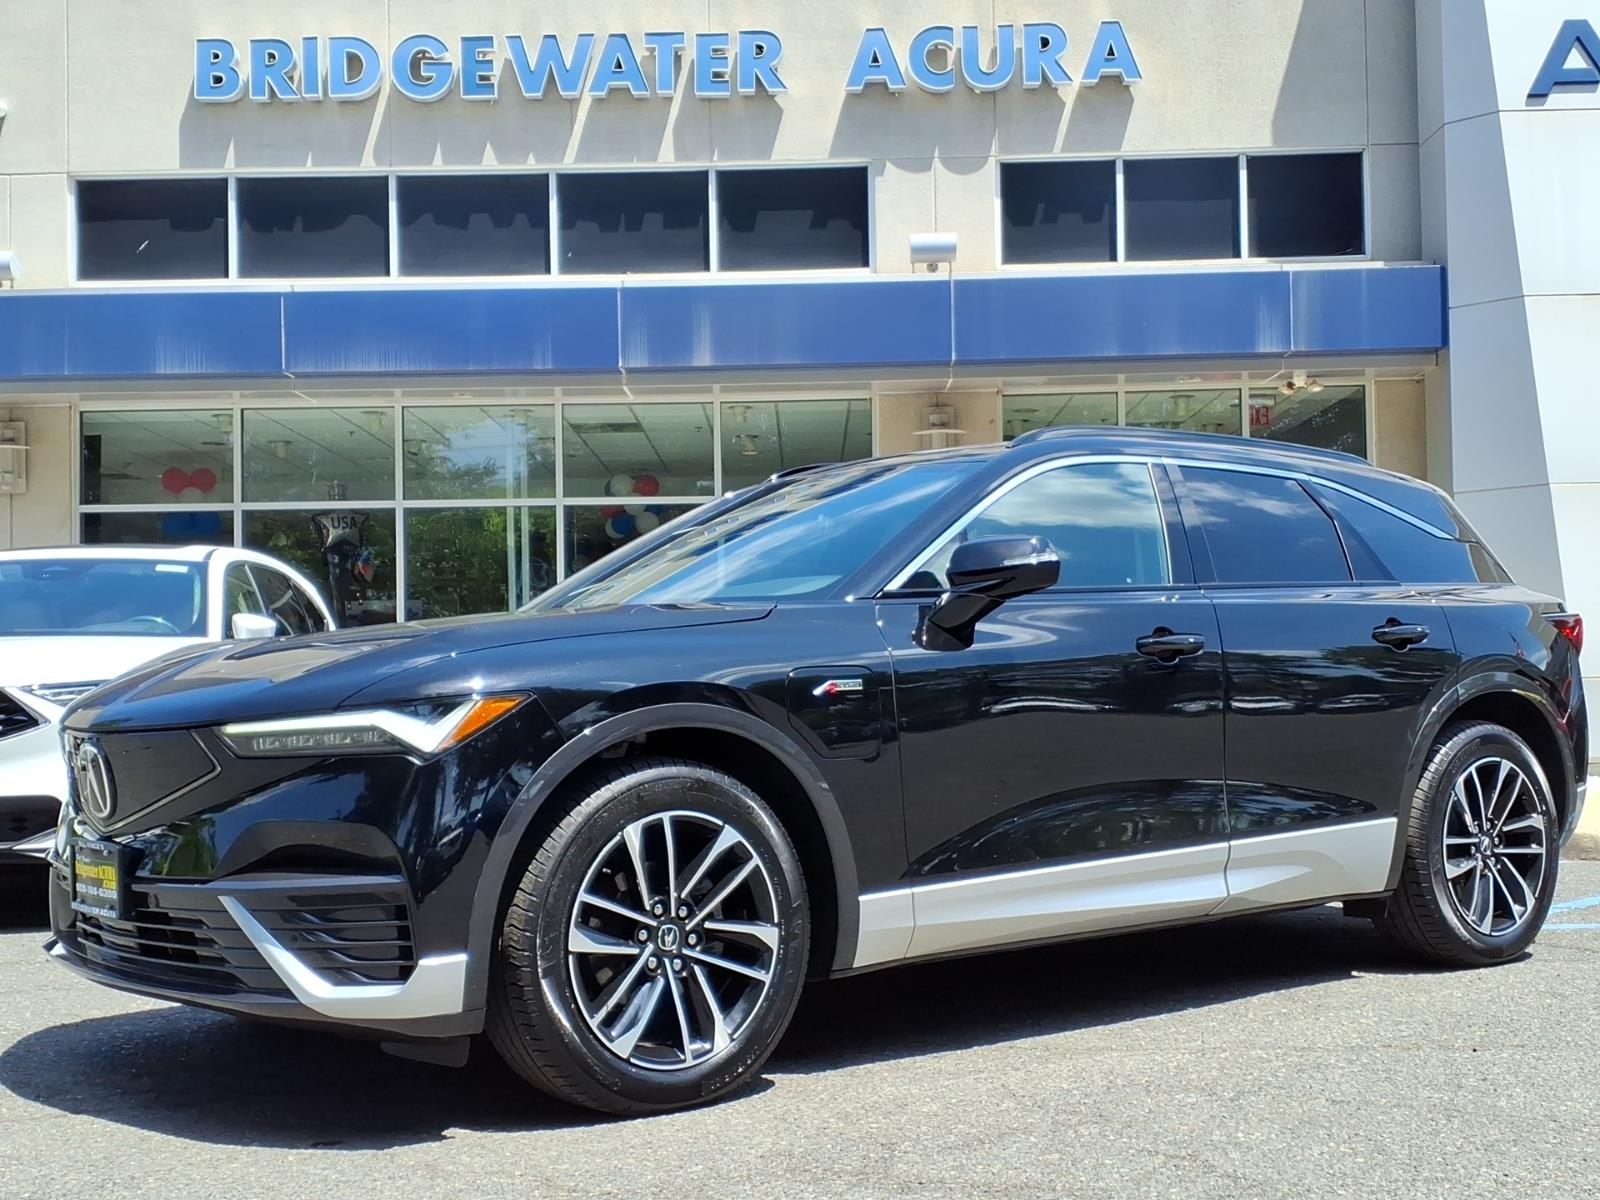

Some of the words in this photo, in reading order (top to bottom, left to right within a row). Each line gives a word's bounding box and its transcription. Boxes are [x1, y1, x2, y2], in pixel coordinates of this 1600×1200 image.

[194, 30, 788, 102] BRIDGEWATER
[845, 20, 1143, 94] ACURA
[331, 516, 358, 529] USA
